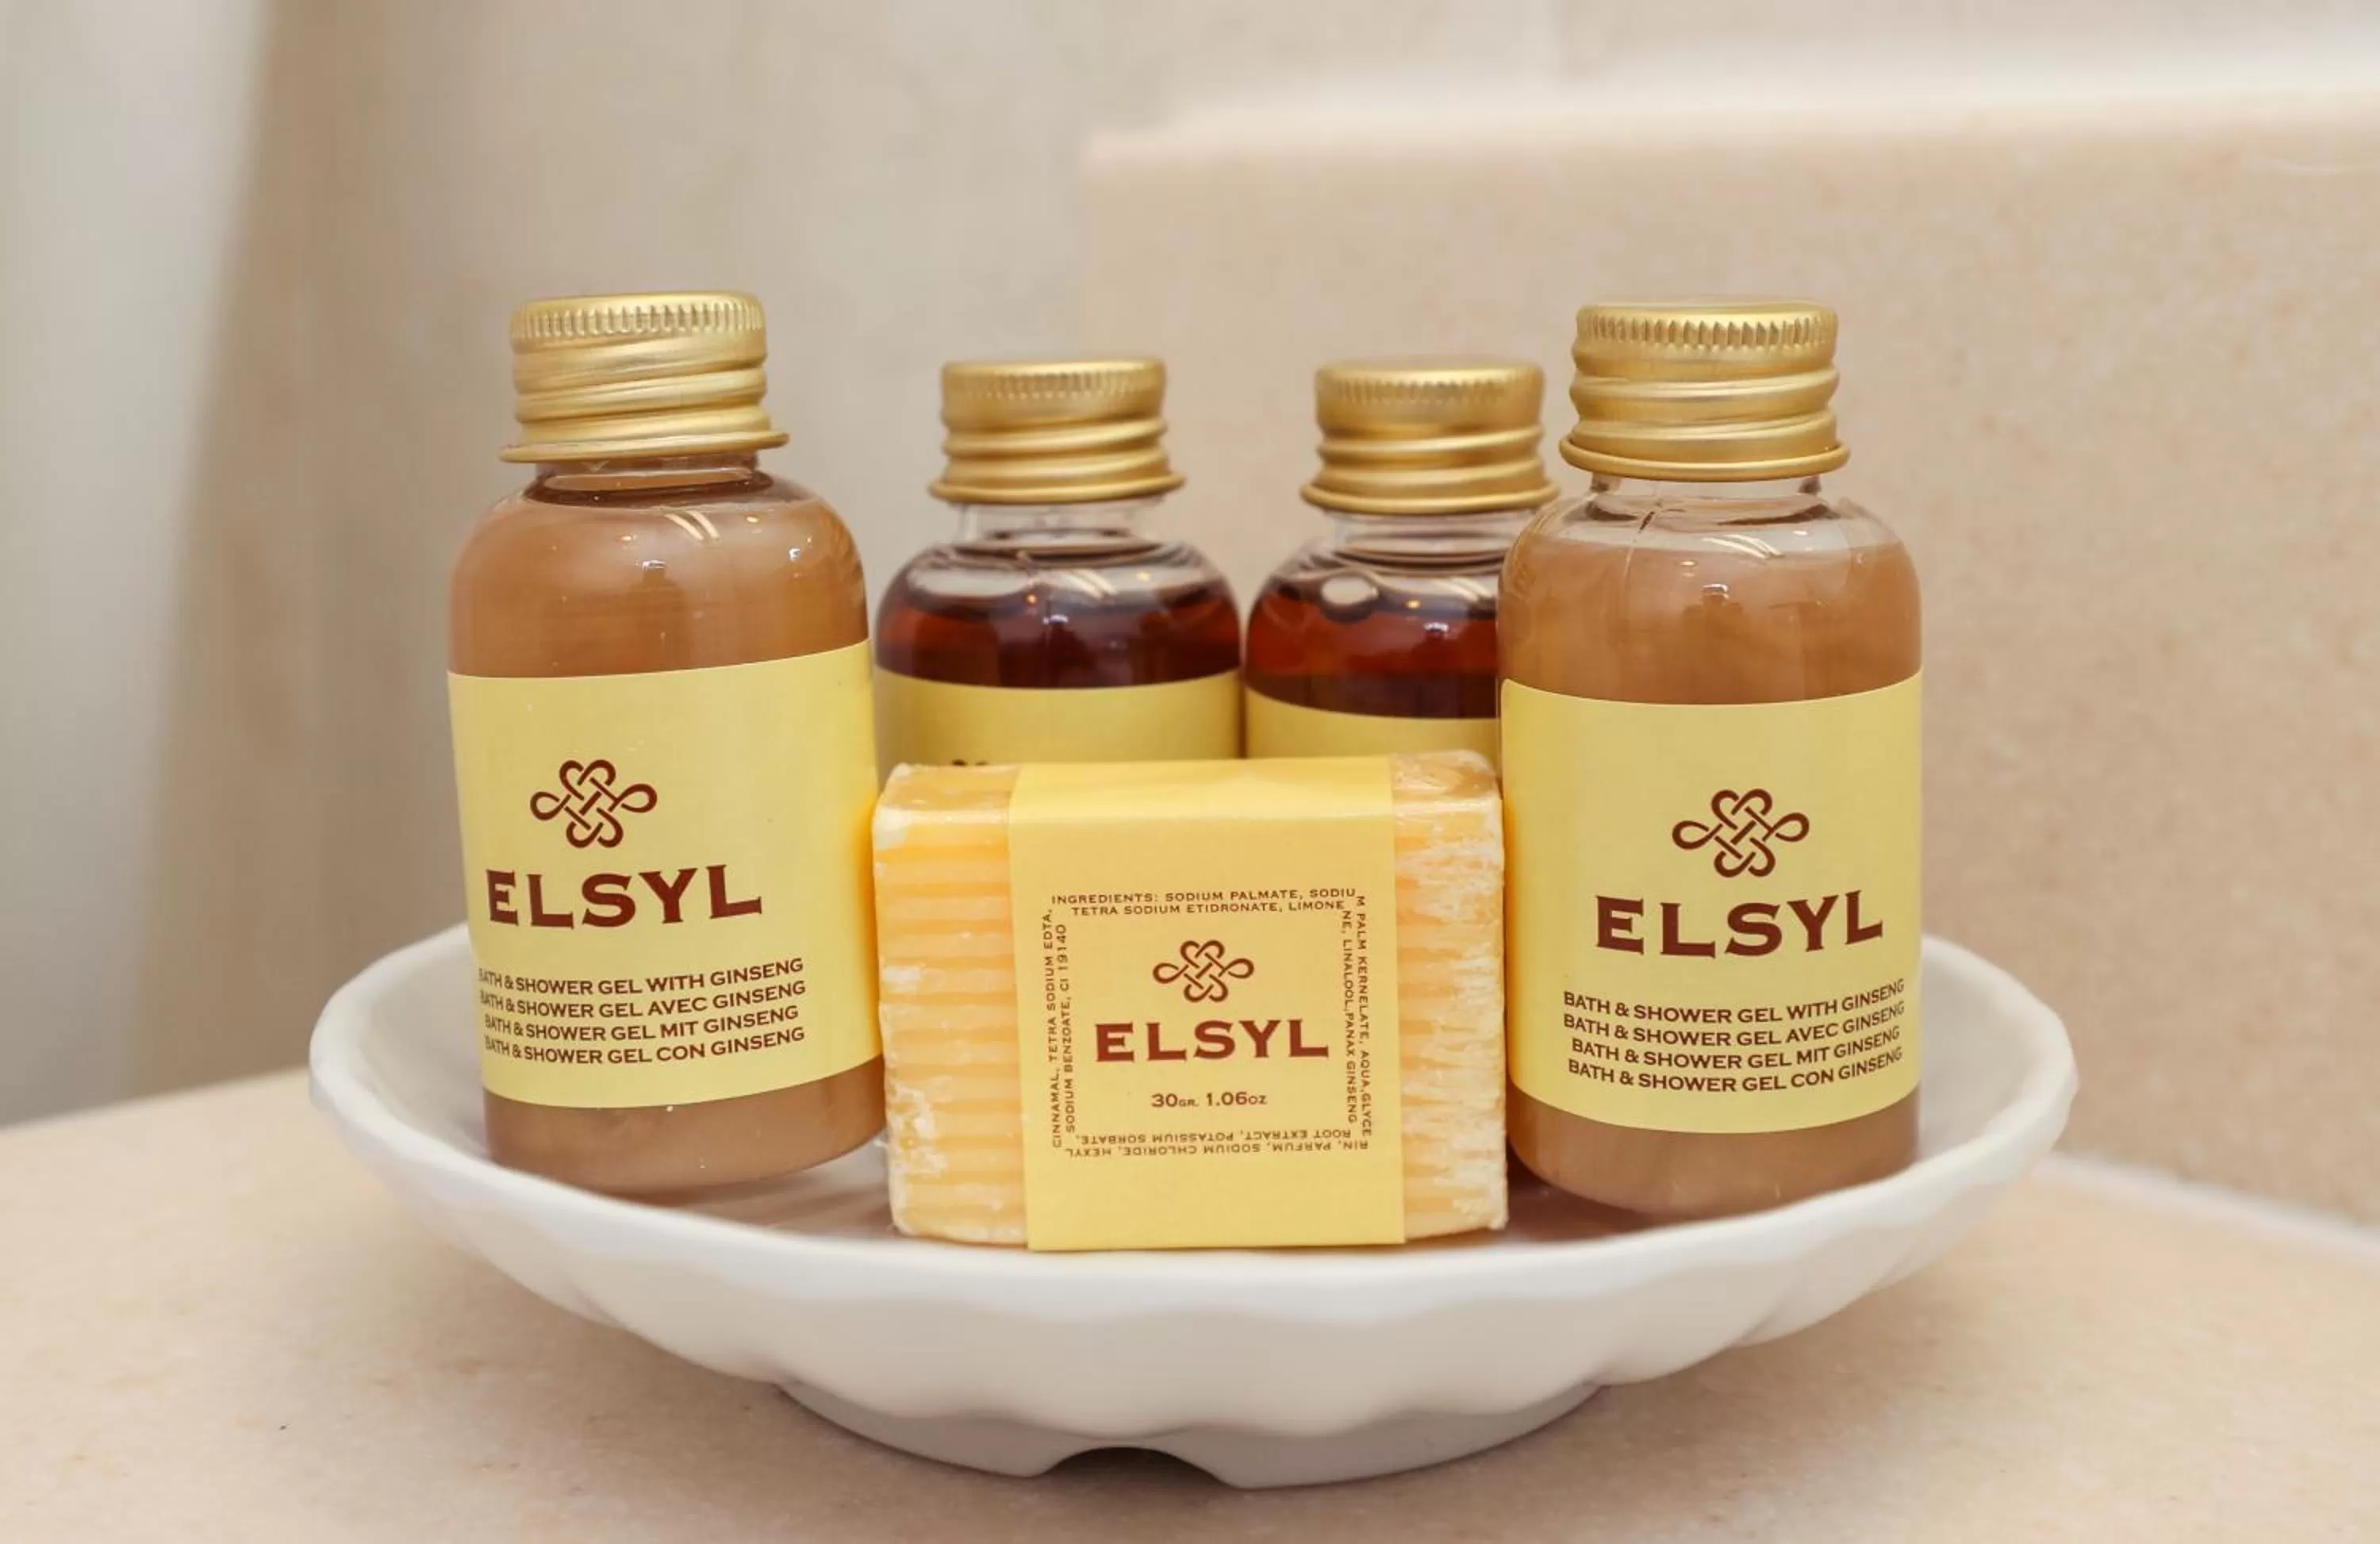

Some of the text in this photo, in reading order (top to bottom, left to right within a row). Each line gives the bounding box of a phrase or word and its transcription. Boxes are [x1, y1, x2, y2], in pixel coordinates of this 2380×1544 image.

[486, 864, 762, 930] ELSYL
[1051, 893, 1157, 905] INGREDIENTS:
[1165, 891, 1223, 902] SODIUM
[1230, 889, 1303, 901] PALMATE,
[1071, 901, 1345, 916] TETRA SODIUM ETIDRONATE, LIMONE
[1357, 913, 1367, 950] PALM
[1595, 890, 1883, 958] ELSYL
[1056, 924, 1068, 970] 19140
[478, 958, 804, 995] BATH & SHOWER GEL WITH GINSENG
[1044, 956, 1056, 1011] SODIUM
[480, 980, 806, 1018] BATH & SHOWER GEL AVEC GINSENG
[1564, 977, 1904, 1024] BATH & SHOWER GEL WITH GINSENG
[485, 1005, 799, 1041] BATH & SHOWER GEL MIT GINSENG
[1047, 1016, 1058, 1062] TETRA
[1095, 1018, 1329, 1062] ELSYL
[1564, 1001, 1904, 1047] BATH & SHOWER GEL AVEC GINSENG
[484, 1027, 804, 1064] BATH & SHOWER GEL CON GINSENG
[1572, 1025, 1900, 1069] BATH & SHOWER GEL MIT GINSENG
[1568, 1047, 1903, 1092] BATH & SHOWER GEL CON GINSENG
[1064, 1078, 1075, 1133] SODIUM
[1346, 1061, 1357, 1124] GINSENG
[1065, 1146, 1111, 1158] HEXYL
[1152, 1131, 1234, 1143] POTASSIUM
[1203, 1143, 1261, 1154] SODIUM
[1314, 1129, 1351, 1139] ROOT
